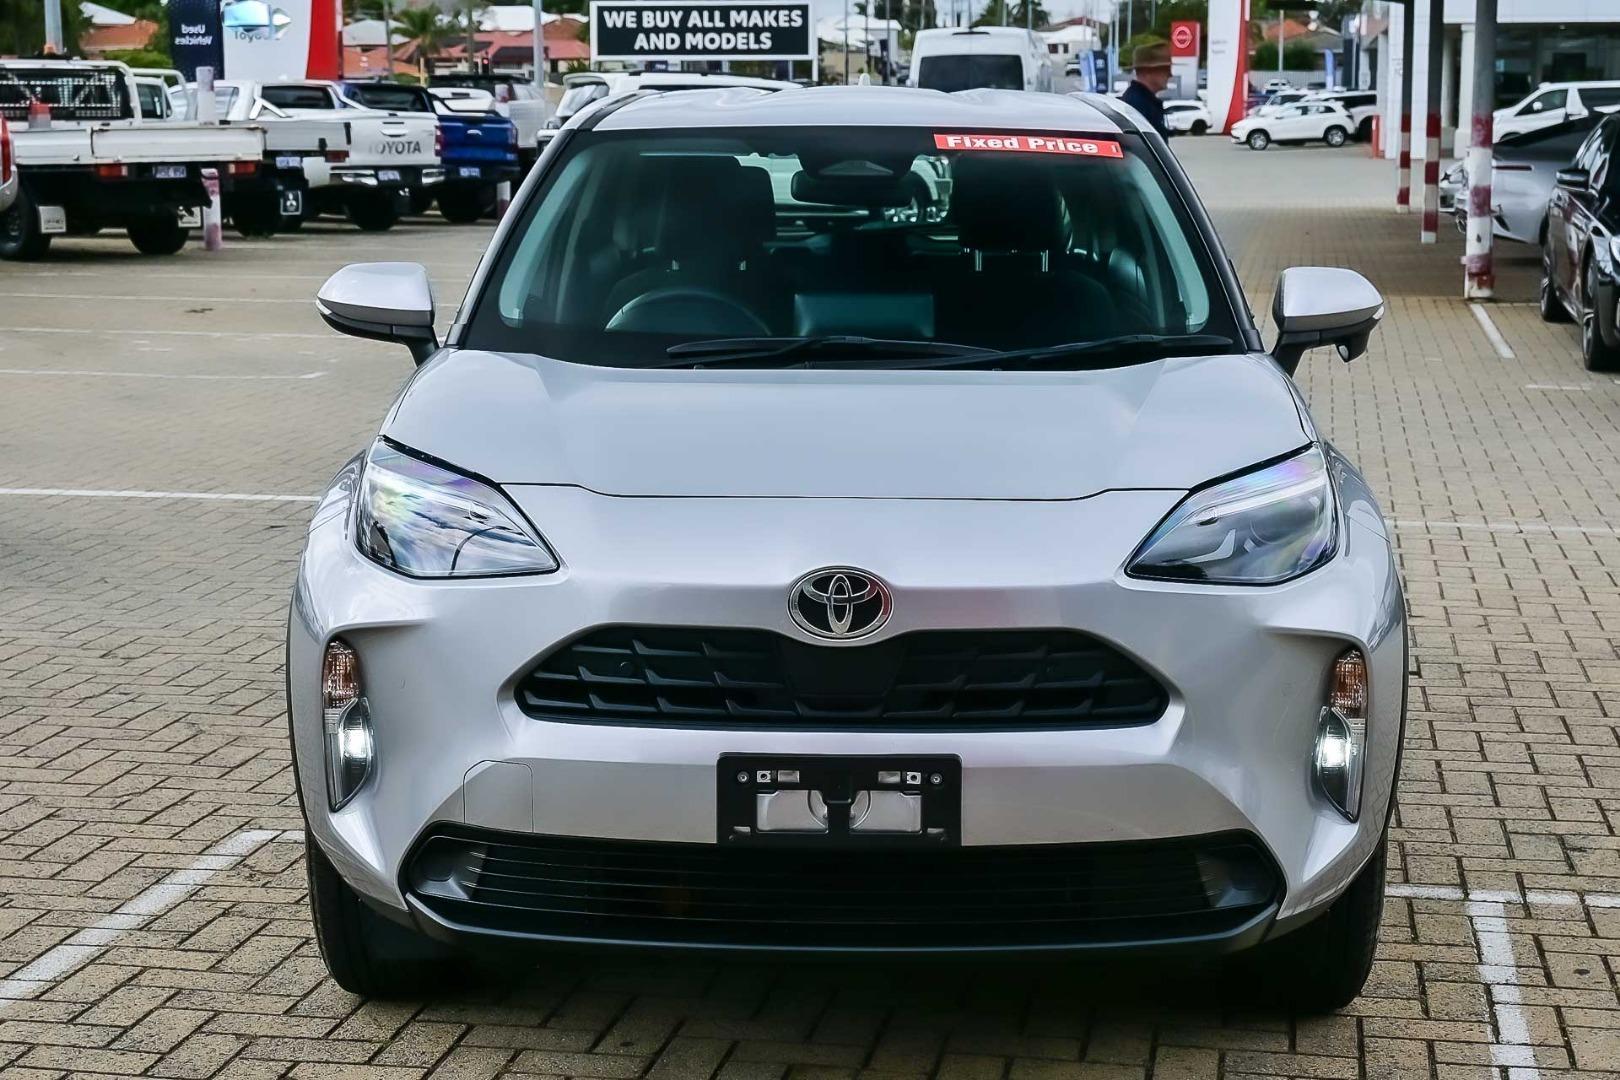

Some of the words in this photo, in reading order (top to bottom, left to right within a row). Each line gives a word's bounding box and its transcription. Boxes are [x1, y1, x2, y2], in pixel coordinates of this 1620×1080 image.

[603, 10, 637, 28] WE
[642, 10, 685, 28] BUY
[687, 10, 725, 28] ALL
[730, 9, 803, 28] MAKES
[634, 32, 681, 50] AND
[685, 32, 772, 50] MODELS
[368, 140, 422, 155] OYOTA
[946, 135, 1019, 149] Fixed
[1026, 137, 1098, 154] Price
